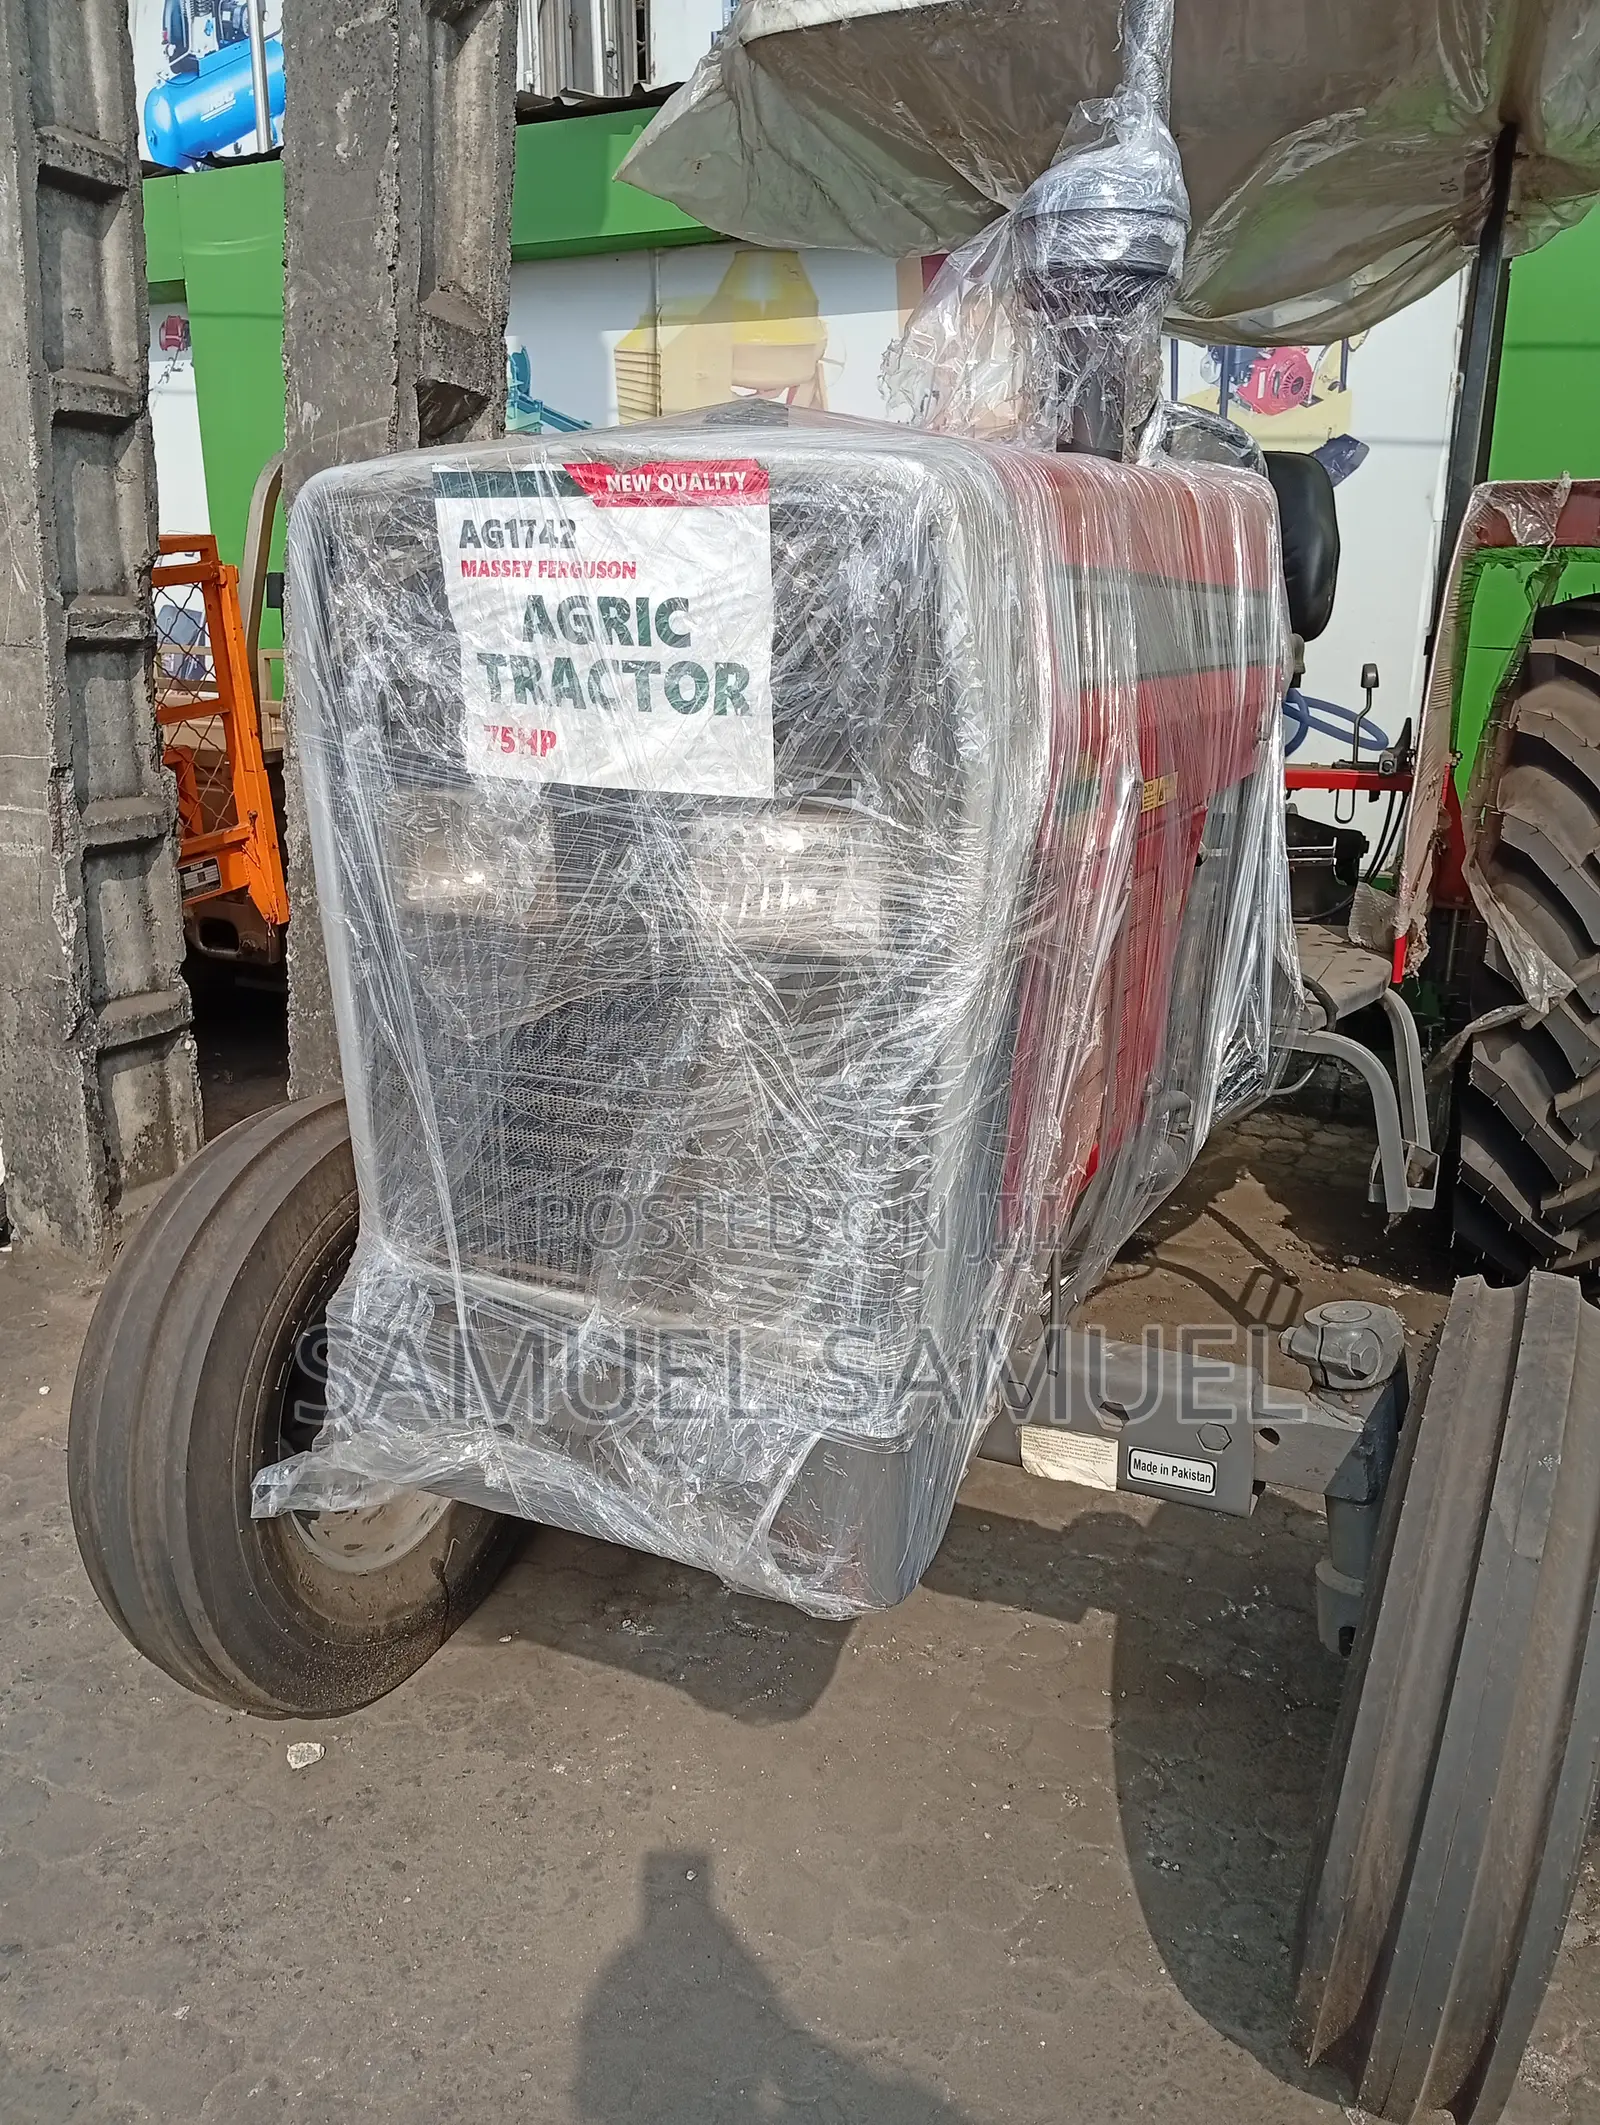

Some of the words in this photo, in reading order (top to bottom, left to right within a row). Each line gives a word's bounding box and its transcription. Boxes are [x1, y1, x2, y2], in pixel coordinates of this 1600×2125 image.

[606, 473, 651, 493] NEW
[657, 472, 747, 493] QUALITY
[459, 519, 576, 549] AG1742
[461, 560, 533, 578] MASSEY
[538, 560, 638, 579] FERGUSON
[522, 594, 692, 649] AGRIC
[476, 653, 753, 717] TRACTOR
[484, 725, 557, 757] 75HP
[1133, 1458, 1157, 1473] Made
[1160, 1463, 1169, 1476] in
[1171, 1465, 1211, 1483] Pakistan
